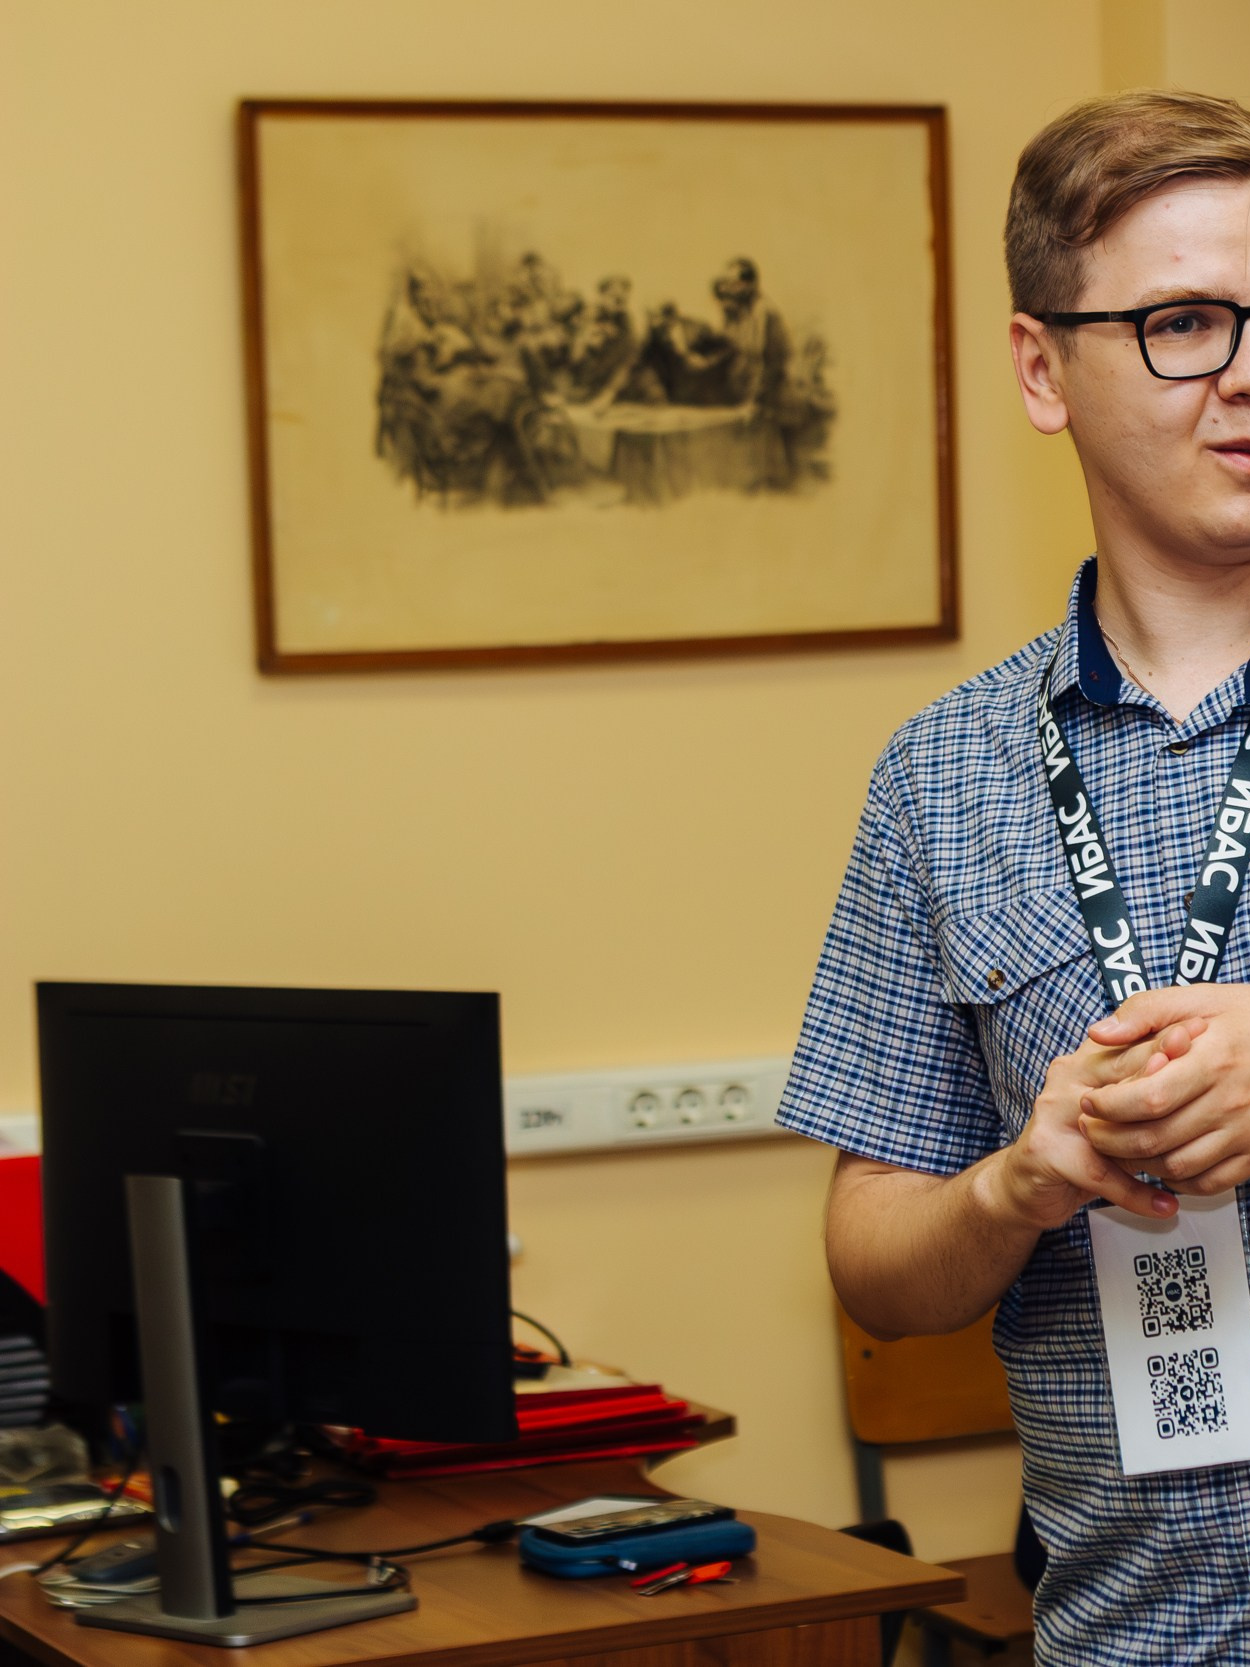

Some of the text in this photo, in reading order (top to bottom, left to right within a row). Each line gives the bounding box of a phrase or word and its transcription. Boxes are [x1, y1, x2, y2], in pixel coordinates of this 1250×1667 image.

[1059, 791, 1115, 900] ИБАС
[1093, 918, 1147, 1003] БАС
[1176, 917, 1226, 987] ИБ
